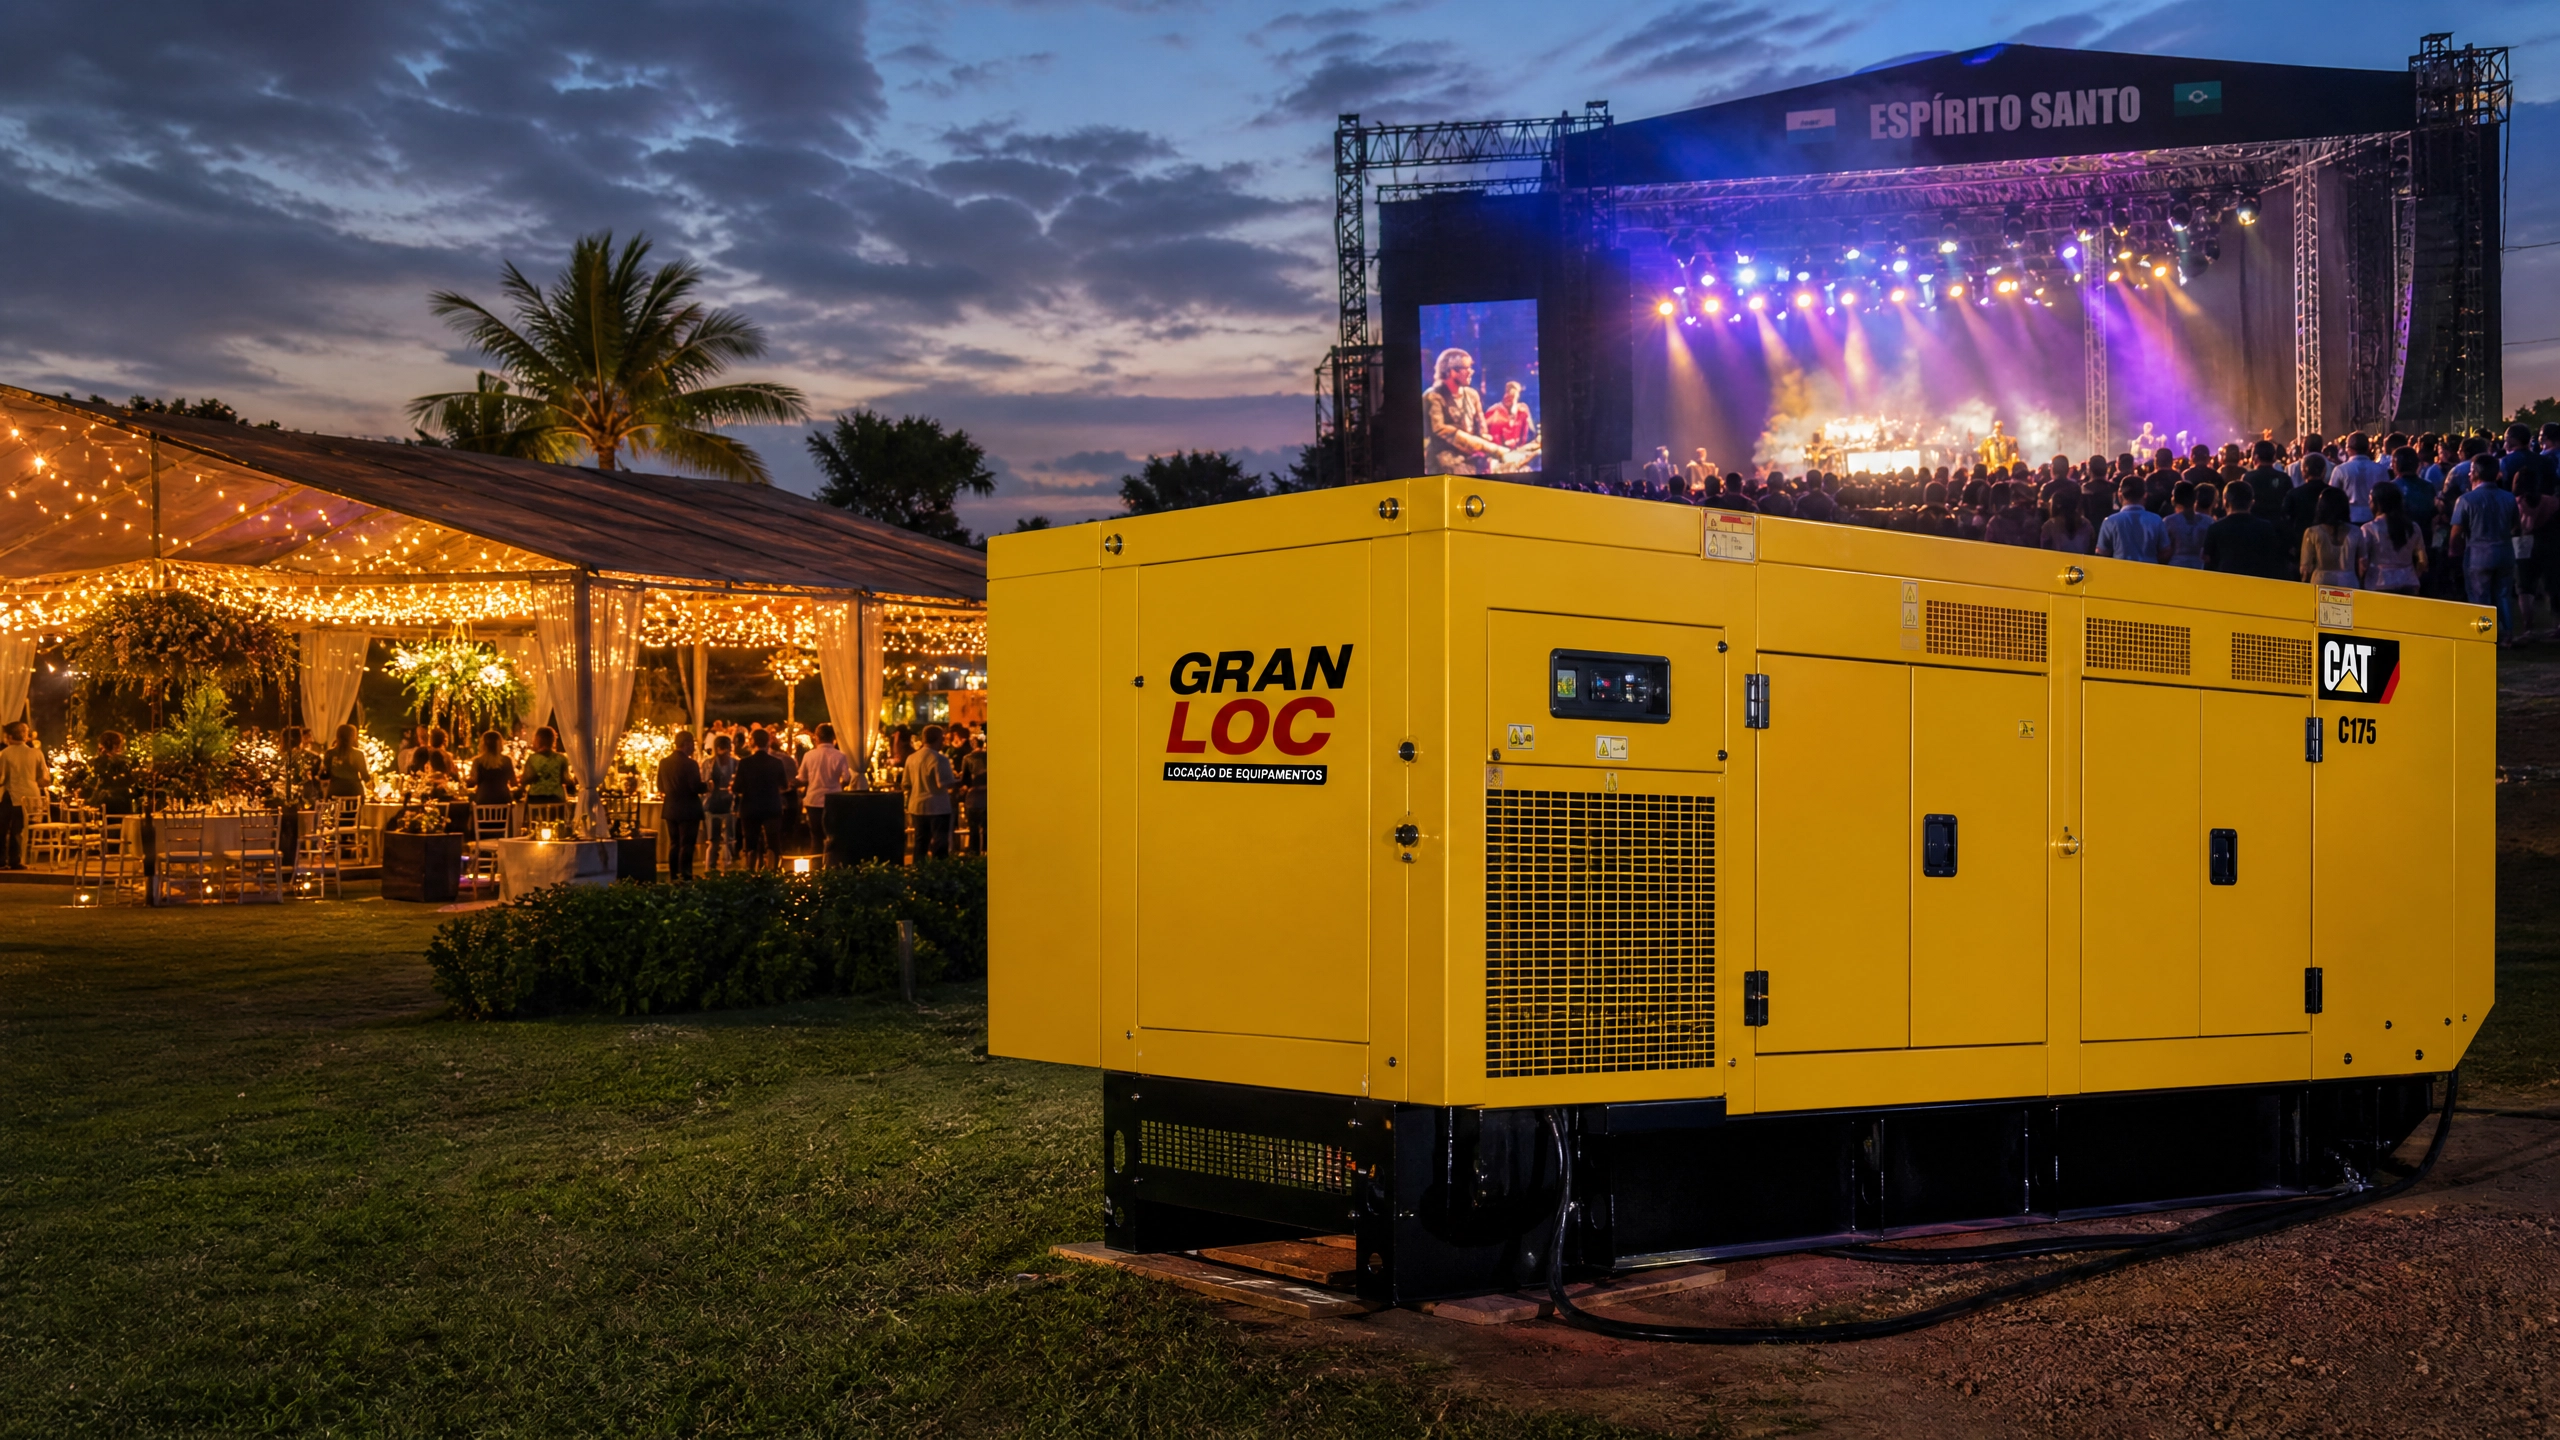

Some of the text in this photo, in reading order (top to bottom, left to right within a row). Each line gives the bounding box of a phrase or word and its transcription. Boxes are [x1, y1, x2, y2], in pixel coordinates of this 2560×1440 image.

[1870, 85, 2141, 140] ESPÍRITO SANTO
[1169, 643, 1354, 695] GRAN
[2324, 640, 2372, 694] CAT
[1165, 696, 1335, 756] LOC
[2338, 715, 2377, 745] C175
[1167, 764, 1323, 781] LOCAÇÃO DE EQUIPAMENTOS
